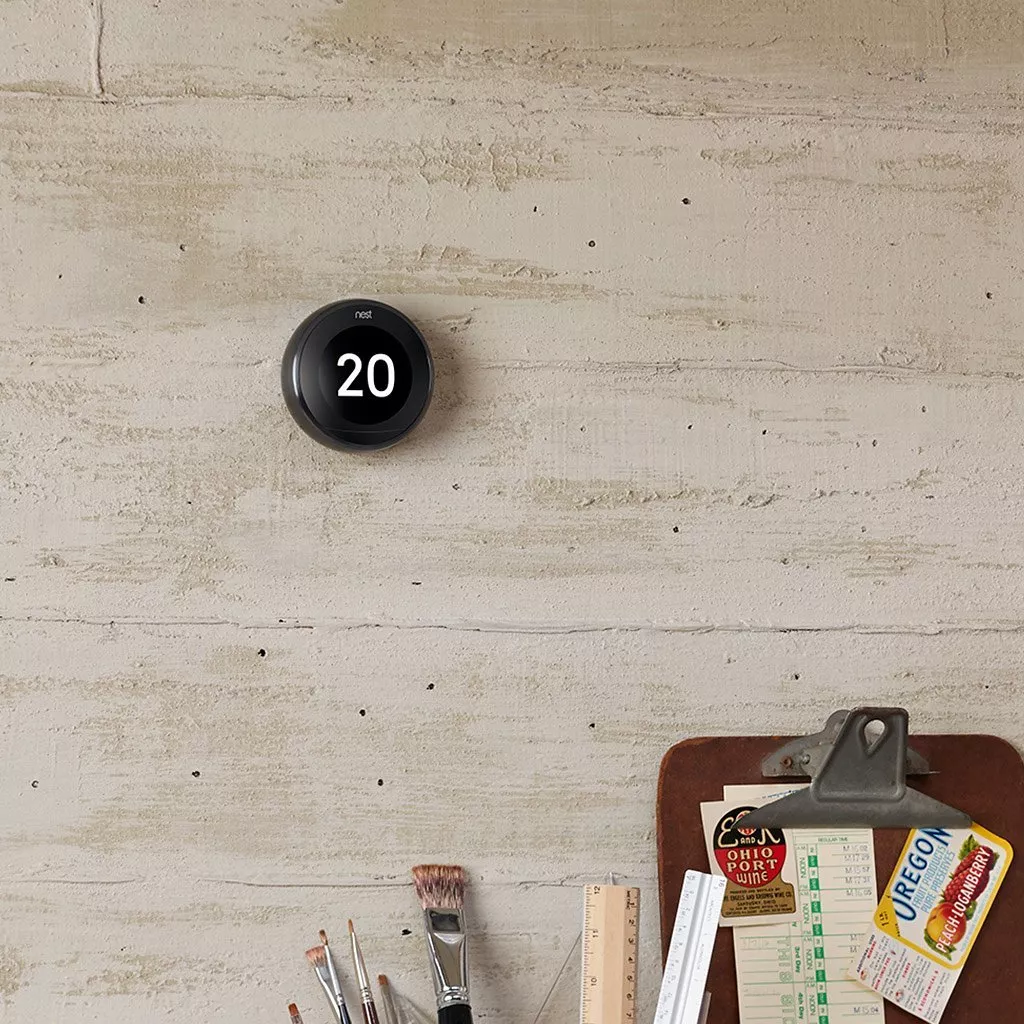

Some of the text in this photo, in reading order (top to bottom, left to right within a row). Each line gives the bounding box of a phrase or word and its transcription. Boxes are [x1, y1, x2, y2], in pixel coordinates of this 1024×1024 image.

[355, 310, 372, 319] nest
[337, 353, 395, 398] 20
[727, 847, 773, 860] OHIO
[727, 859, 777, 872] PORT
[736, 872, 768, 885] WINE
[892, 828, 953, 921] OREGON
[912, 845, 946, 909] FRUIT PRODUCTS
[920, 850, 956, 913] PURE PRESERVES
[594, 886, 601, 895] 12
[593, 929, 598, 938] 11
[591, 977, 597, 986] 10
